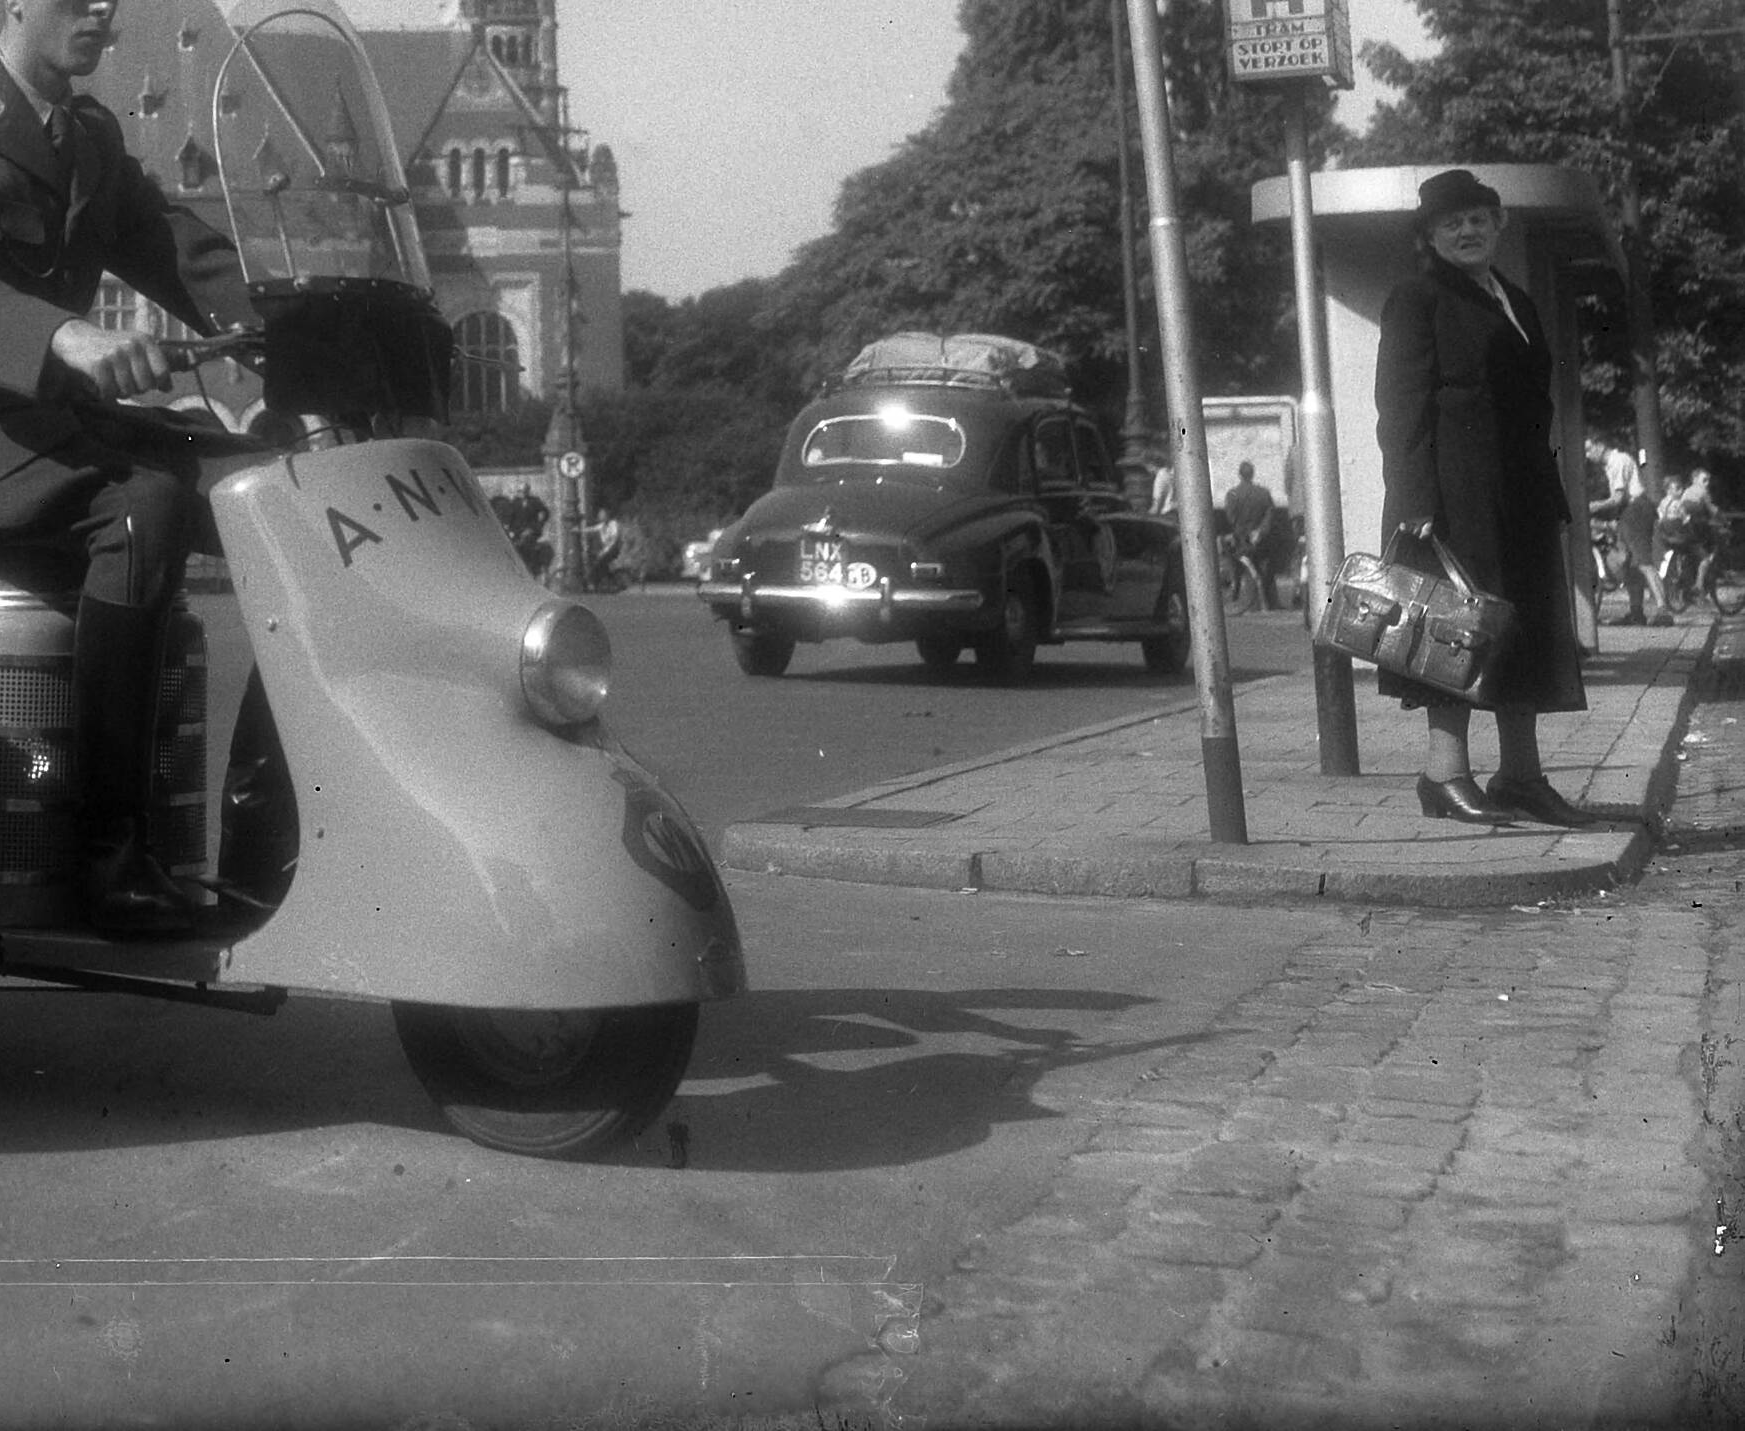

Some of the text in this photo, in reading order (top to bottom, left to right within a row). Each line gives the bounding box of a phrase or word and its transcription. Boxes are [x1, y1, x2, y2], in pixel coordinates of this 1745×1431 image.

[1256, 22, 1304, 35] TRAM
[1299, 38, 1322, 50] OP
[1238, 52, 1324, 70] VERZOEK
[800, 539, 842, 561] LNX
[800, 561, 844, 583] 564
